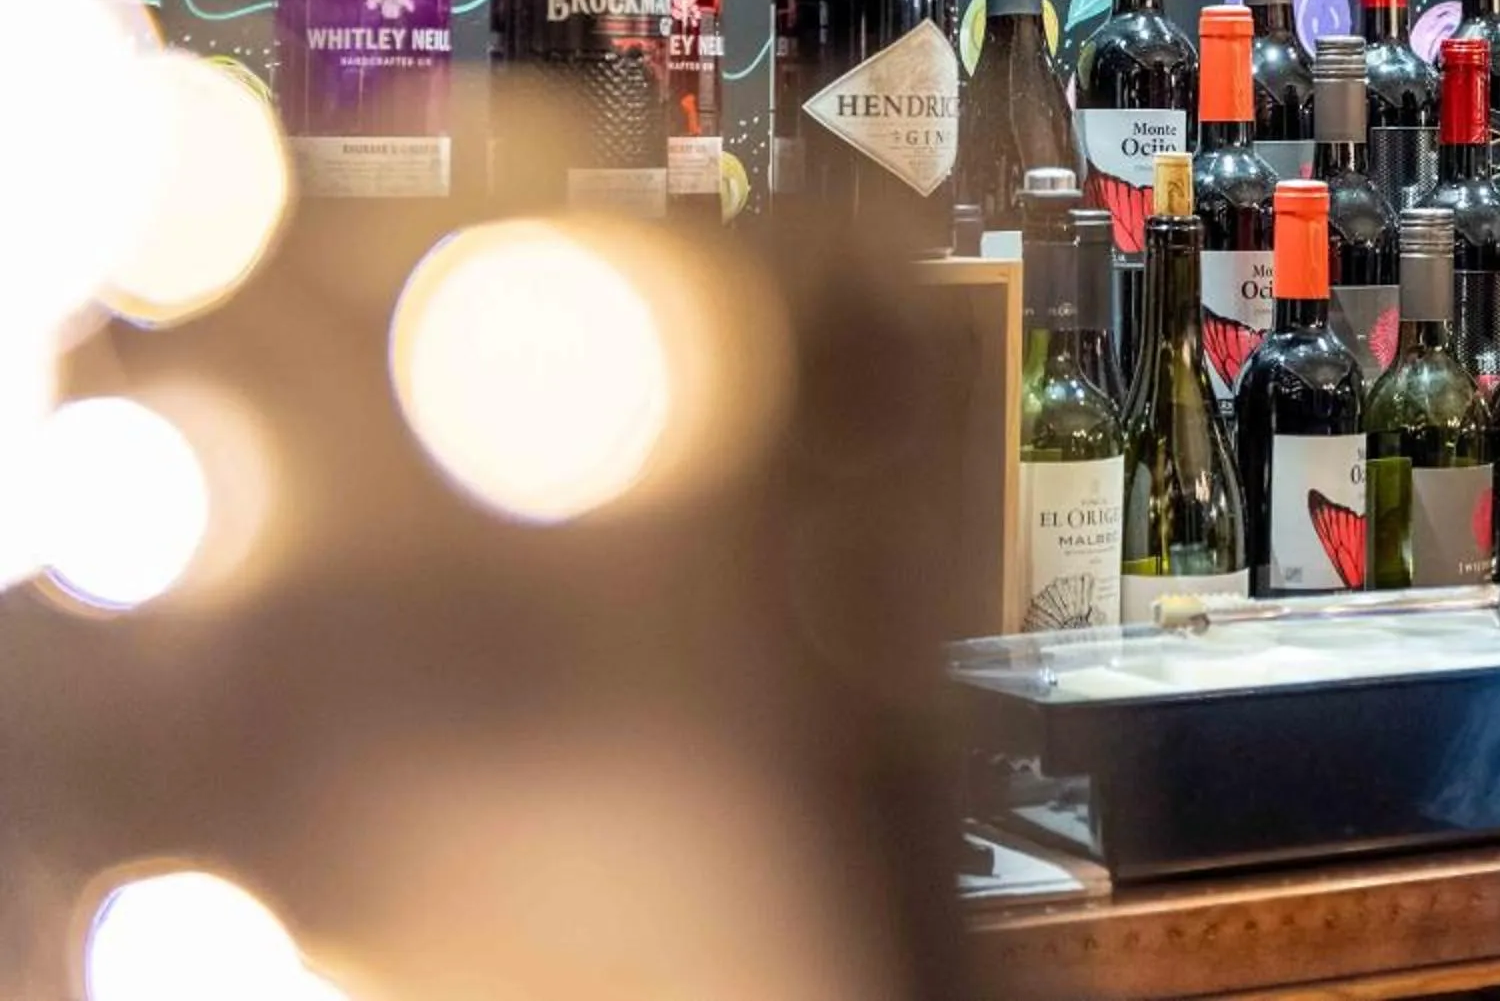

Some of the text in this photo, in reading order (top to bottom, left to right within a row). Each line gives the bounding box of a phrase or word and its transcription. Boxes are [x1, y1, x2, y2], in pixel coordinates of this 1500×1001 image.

[306, 28, 406, 50] WHITLEY
[905, 129, 944, 146] GIN
[1133, 122, 1178, 136] Monte
